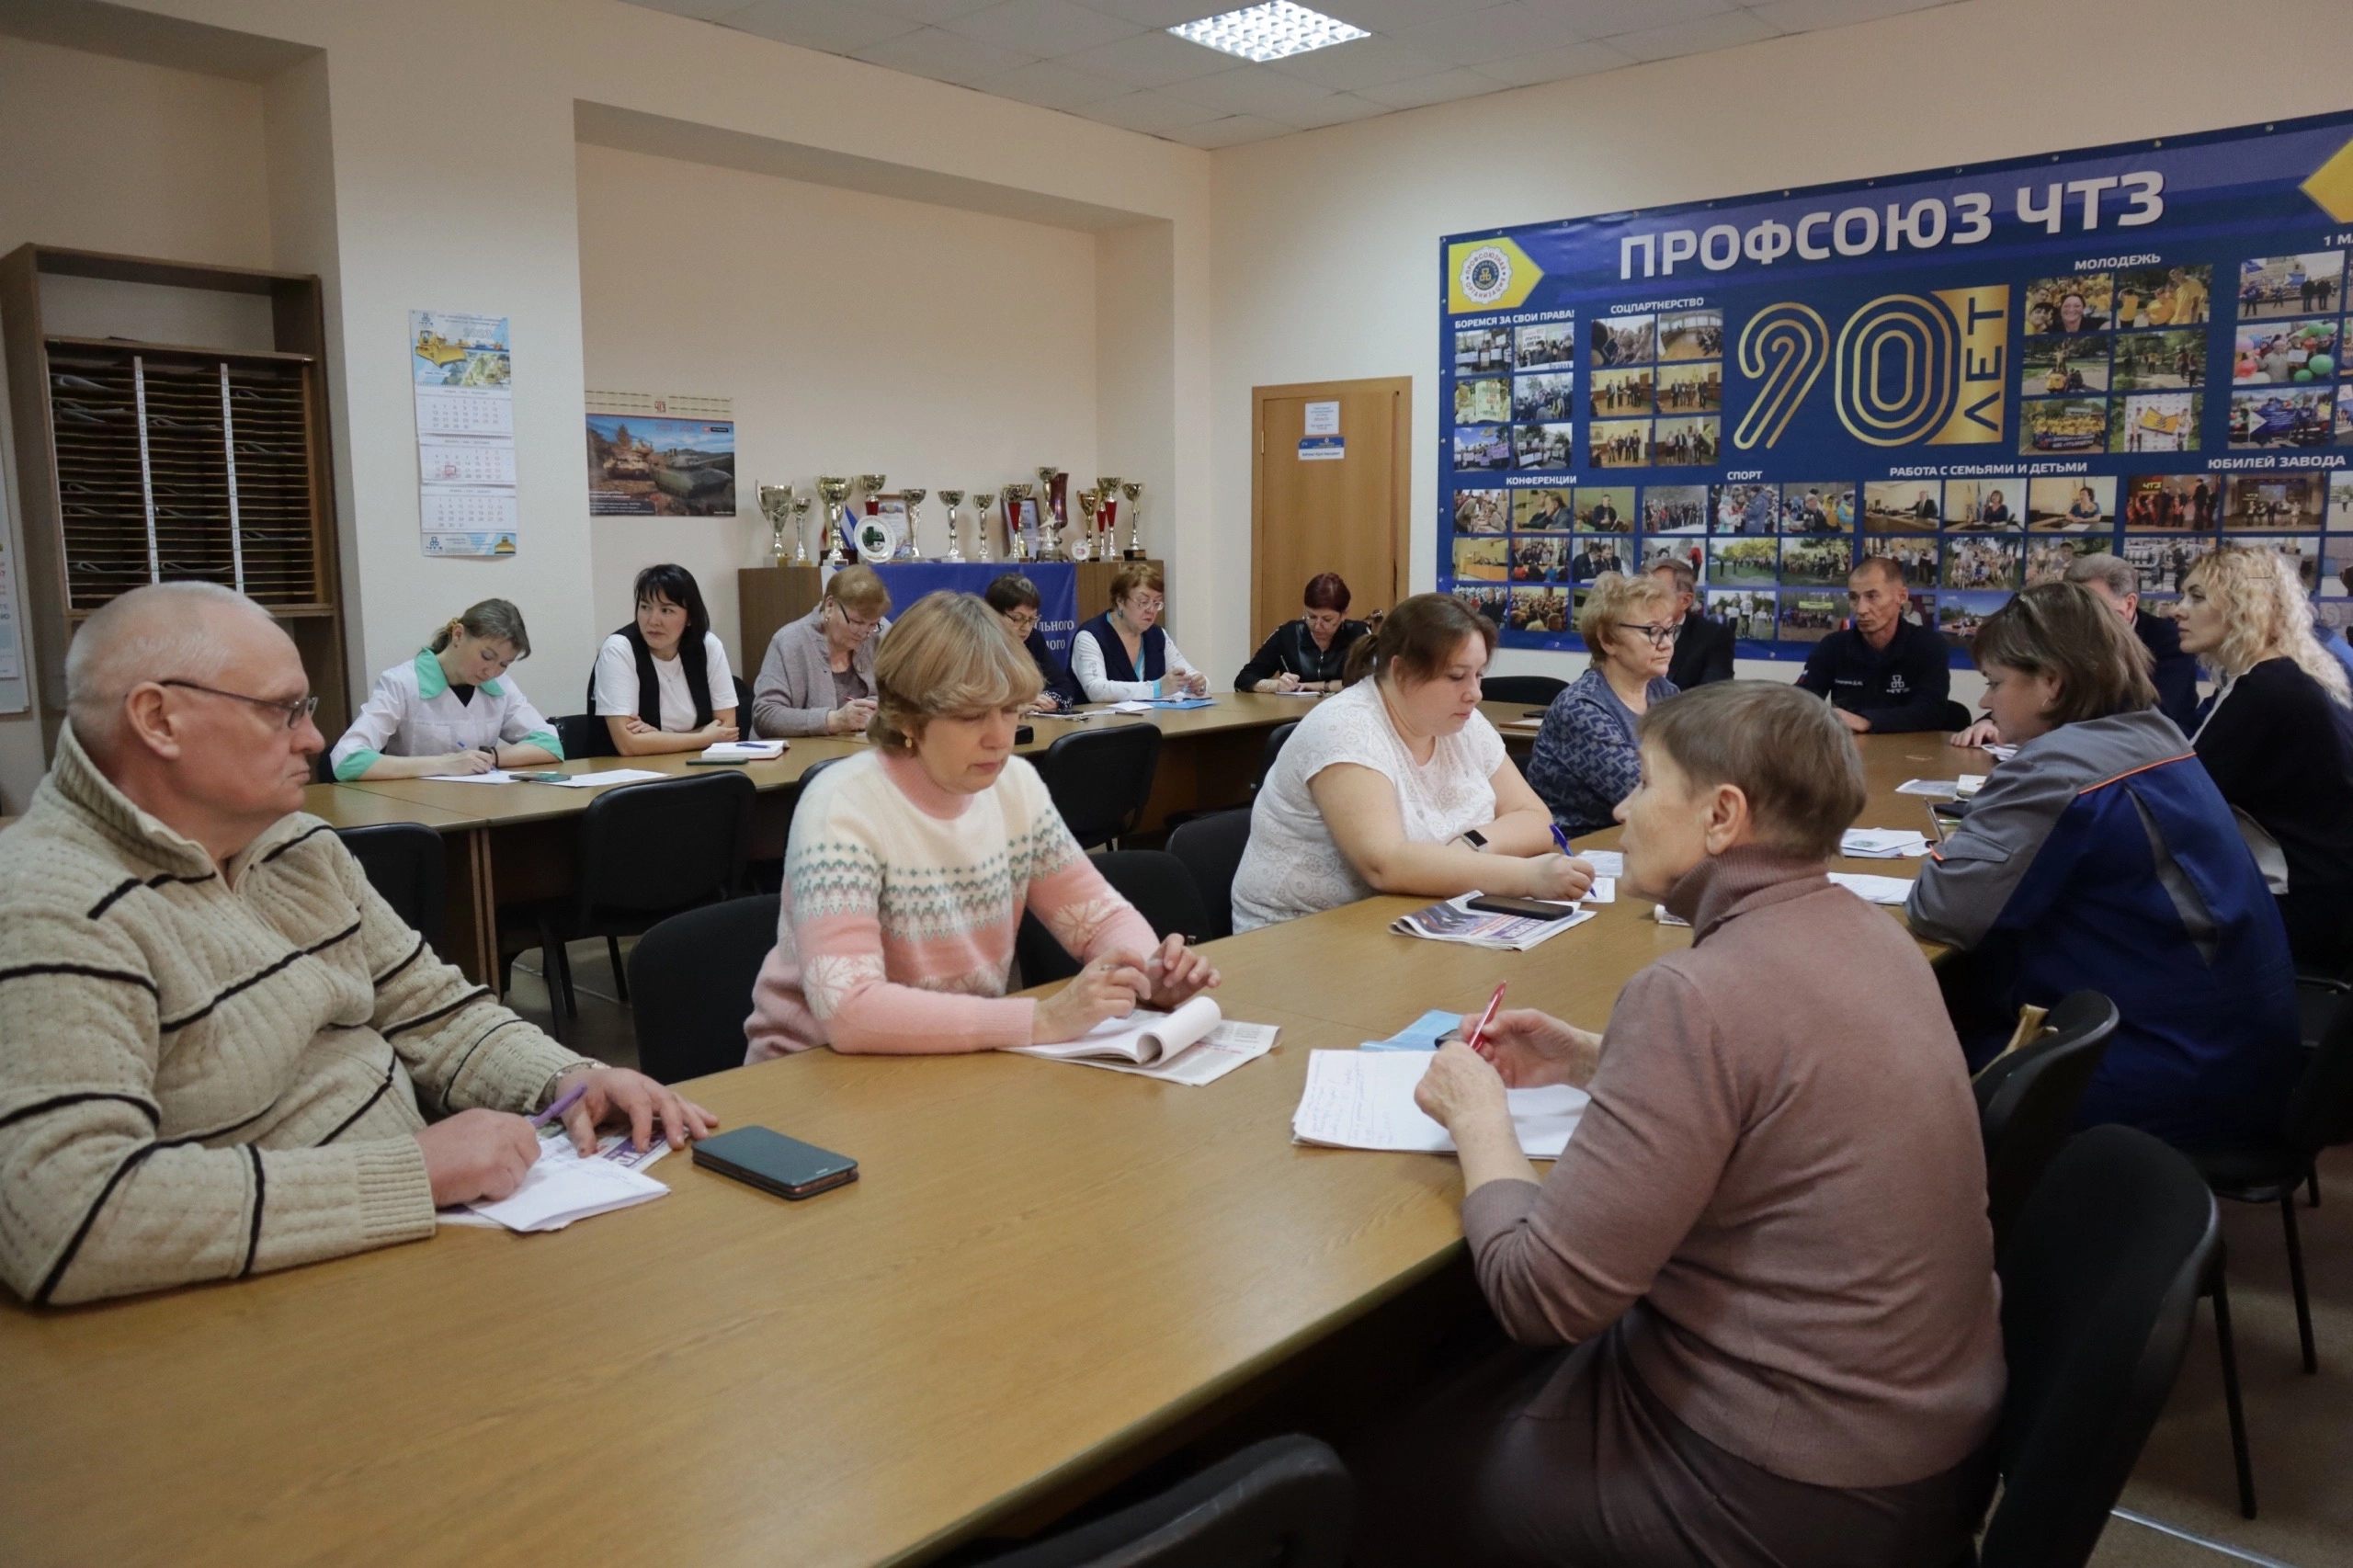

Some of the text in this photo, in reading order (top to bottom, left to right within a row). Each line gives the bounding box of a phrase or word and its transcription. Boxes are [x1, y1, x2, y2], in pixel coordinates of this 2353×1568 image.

[1620, 170, 2165, 280] ПРОФСОЮЗ ЧТЗ
[2324, 233, 2353, 246] 1 М
[1465, 252, 1506, 275] ПРОФСОЮЗНАЯ
[2075, 253, 2161, 271] МОЛОДЕЖЬ
[1465, 278, 1506, 299] ОРГАНИЗАЦИЯ
[1610, 297, 1704, 314] СОЦПАРТНЕРСТВО
[1454, 310, 1574, 329] БОРЕМСЯ ЗА СВОИ ПРАВА!
[1733, 294, 2005, 450] 90 ЛЕТ
[1889, 461, 2087, 477] РАБОТА С СЕМЬЯМИ И ДЕТЬМИ
[2208, 454, 2347, 470] ЮБИЛЕЙ ЗАВОДА
[1506, 474, 1577, 485] КОНФЕРЕНЦИИ
[1726, 471, 1763, 481] СПОРТ
[1035, 619, 1074, 632] ЛЬНОГО
